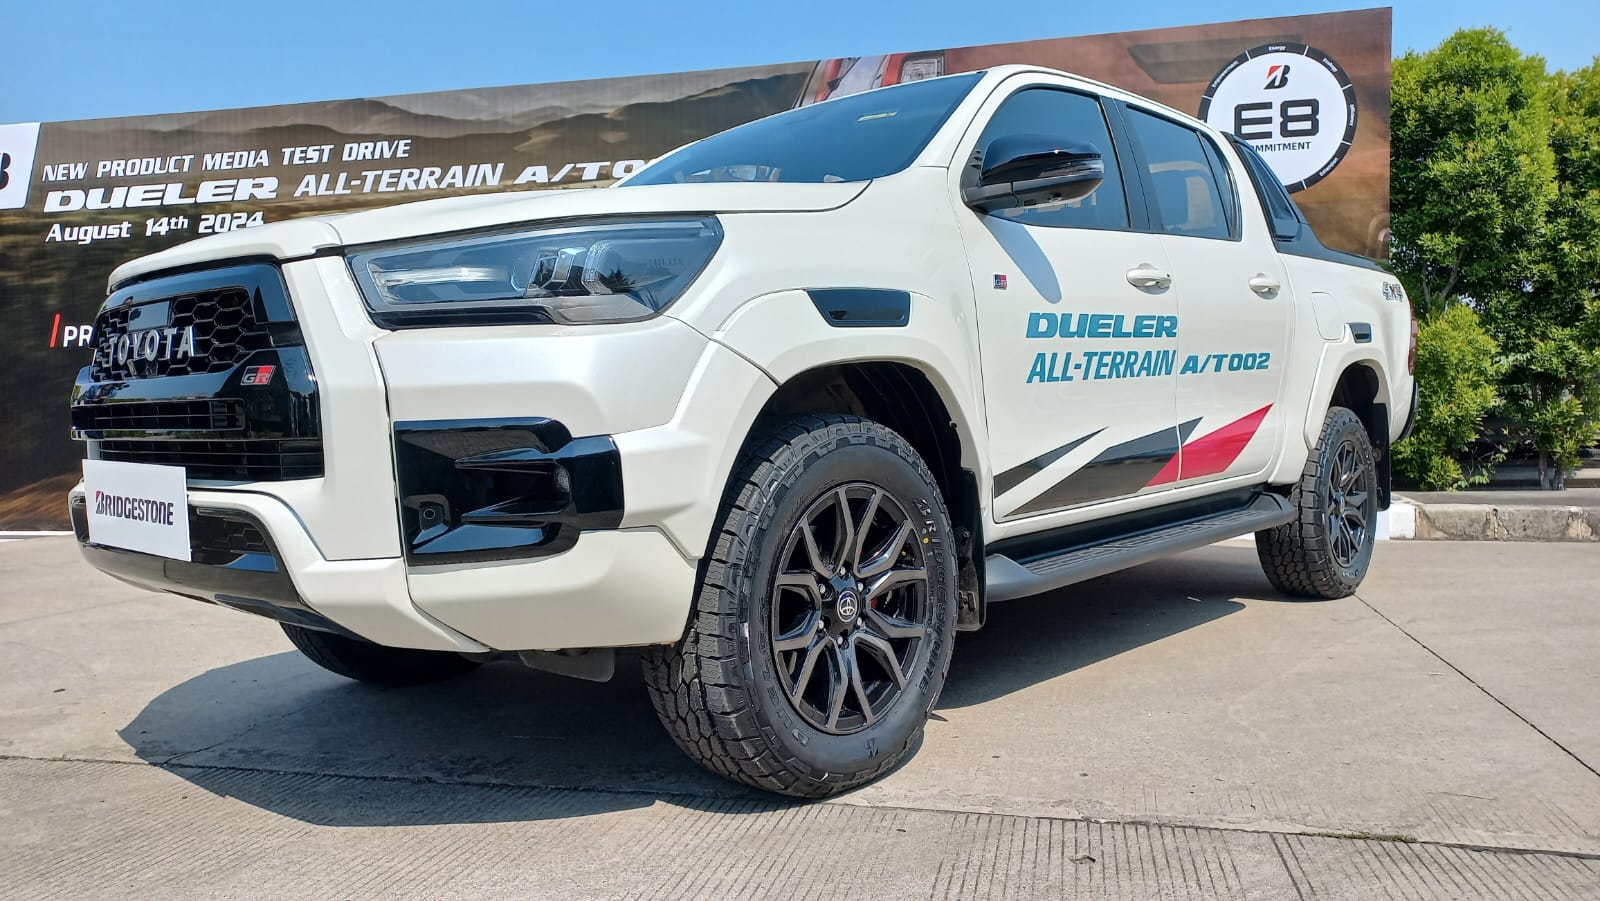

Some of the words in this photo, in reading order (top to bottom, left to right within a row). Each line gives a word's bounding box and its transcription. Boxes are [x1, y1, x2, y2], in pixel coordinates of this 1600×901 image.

[1234, 98, 1320, 140] E8
[41, 161, 90, 183] NEW
[96, 154, 194, 178] PRODUCT
[201, 149, 270, 171] MEDIA
[281, 144, 334, 166] TEST
[341, 139, 412, 162] DRIVE
[1250, 141, 1311, 152] MMITMENT
[44, 177, 278, 212] DUELER
[293, 163, 504, 197] ALL-TERRAIN
[44, 222, 133, 245] August
[145, 215, 190, 237] 14th
[198, 211, 264, 234] 2024
[1026, 312, 1178, 338] DUELER
[109, 325, 195, 367] TOYOTA
[243, 371, 271, 385] GR
[1026, 349, 1177, 384] ALL-TERRAIN
[1180, 352, 1271, 375] A/T002
[96, 490, 174, 526] BRIDGESTONE
